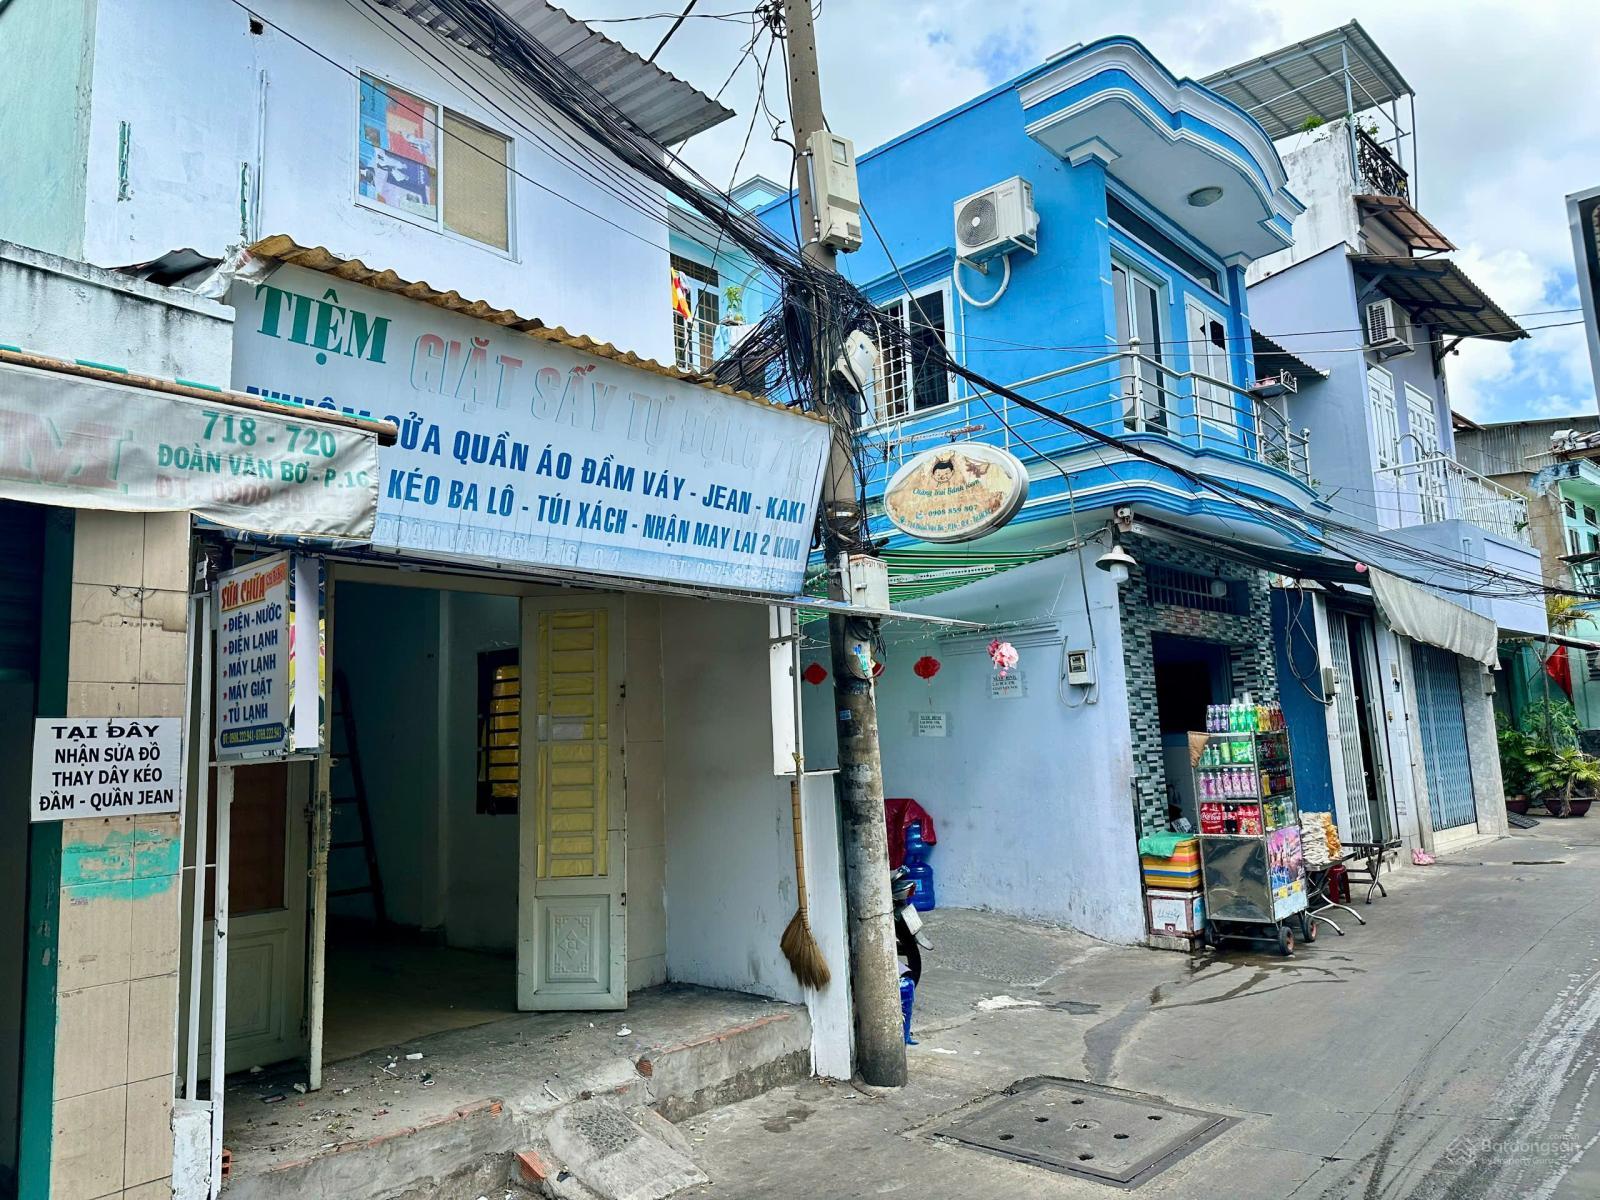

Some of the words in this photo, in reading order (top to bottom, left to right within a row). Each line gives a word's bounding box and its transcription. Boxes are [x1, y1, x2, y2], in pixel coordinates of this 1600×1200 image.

[255, 284, 392, 365] TIỆM
[410, 333, 523, 414] GIẶT
[531, 364, 618, 432] SẤY
[627, 391, 676, 455] TỰ
[201, 410, 258, 447] 718
[286, 423, 337, 458] 720
[157, 441, 221, 474] ĐOÀN
[229, 452, 274, 479] VĂN
[280, 460, 310, 484] BƠ
[323, 468, 370, 489] P.16
[453, 431, 529, 471] QUẦN
[536, 444, 572, 480] ÁO
[580, 454, 635, 492] ĐẦM
[643, 469, 686, 500] VÁY
[702, 484, 752, 515] JEAN
[766, 496, 806, 524] KAKI
[387, 467, 441, 506] KÉO
[447, 480, 479, 512] BA
[487, 484, 515, 517] LÔ
[537, 493, 571, 526] TÚI
[576, 500, 629, 535] XÁCH
[643, 514, 690, 547] NHẬN
[693, 522, 731, 550] MAY
[733, 529, 758, 555] LAI
[760, 534, 771, 556] 2
[773, 536, 801, 561] KIM
[222, 579, 239, 610] SỬA
[240, 571, 265, 603] CHỮA
[228, 635, 250, 655] ĐIỆN
[252, 629, 278, 651] LẠNH
[228, 657, 248, 678] MÁY
[250, 653, 276, 675] LẠNH
[228, 680, 248, 701] MÁY
[250, 677, 272, 700] GIẶT
[228, 702, 240, 723] TỦ
[243, 703, 269, 724] LẠNH
[51, 725, 98, 742] TẠI
[106, 721, 160, 738] ĐÂY
[55, 743, 99, 767] NHẬN
[103, 742, 135, 762] SỬA
[138, 741, 161, 761] ĐỒ
[52, 770, 94, 787] THAY
[98, 764, 129, 785] DÂY
[134, 763, 162, 783] KÉO
[39, 790, 75, 811] ĐẦM
[90, 786, 134, 811] QUẦN
[137, 789, 174, 805] JEAN
